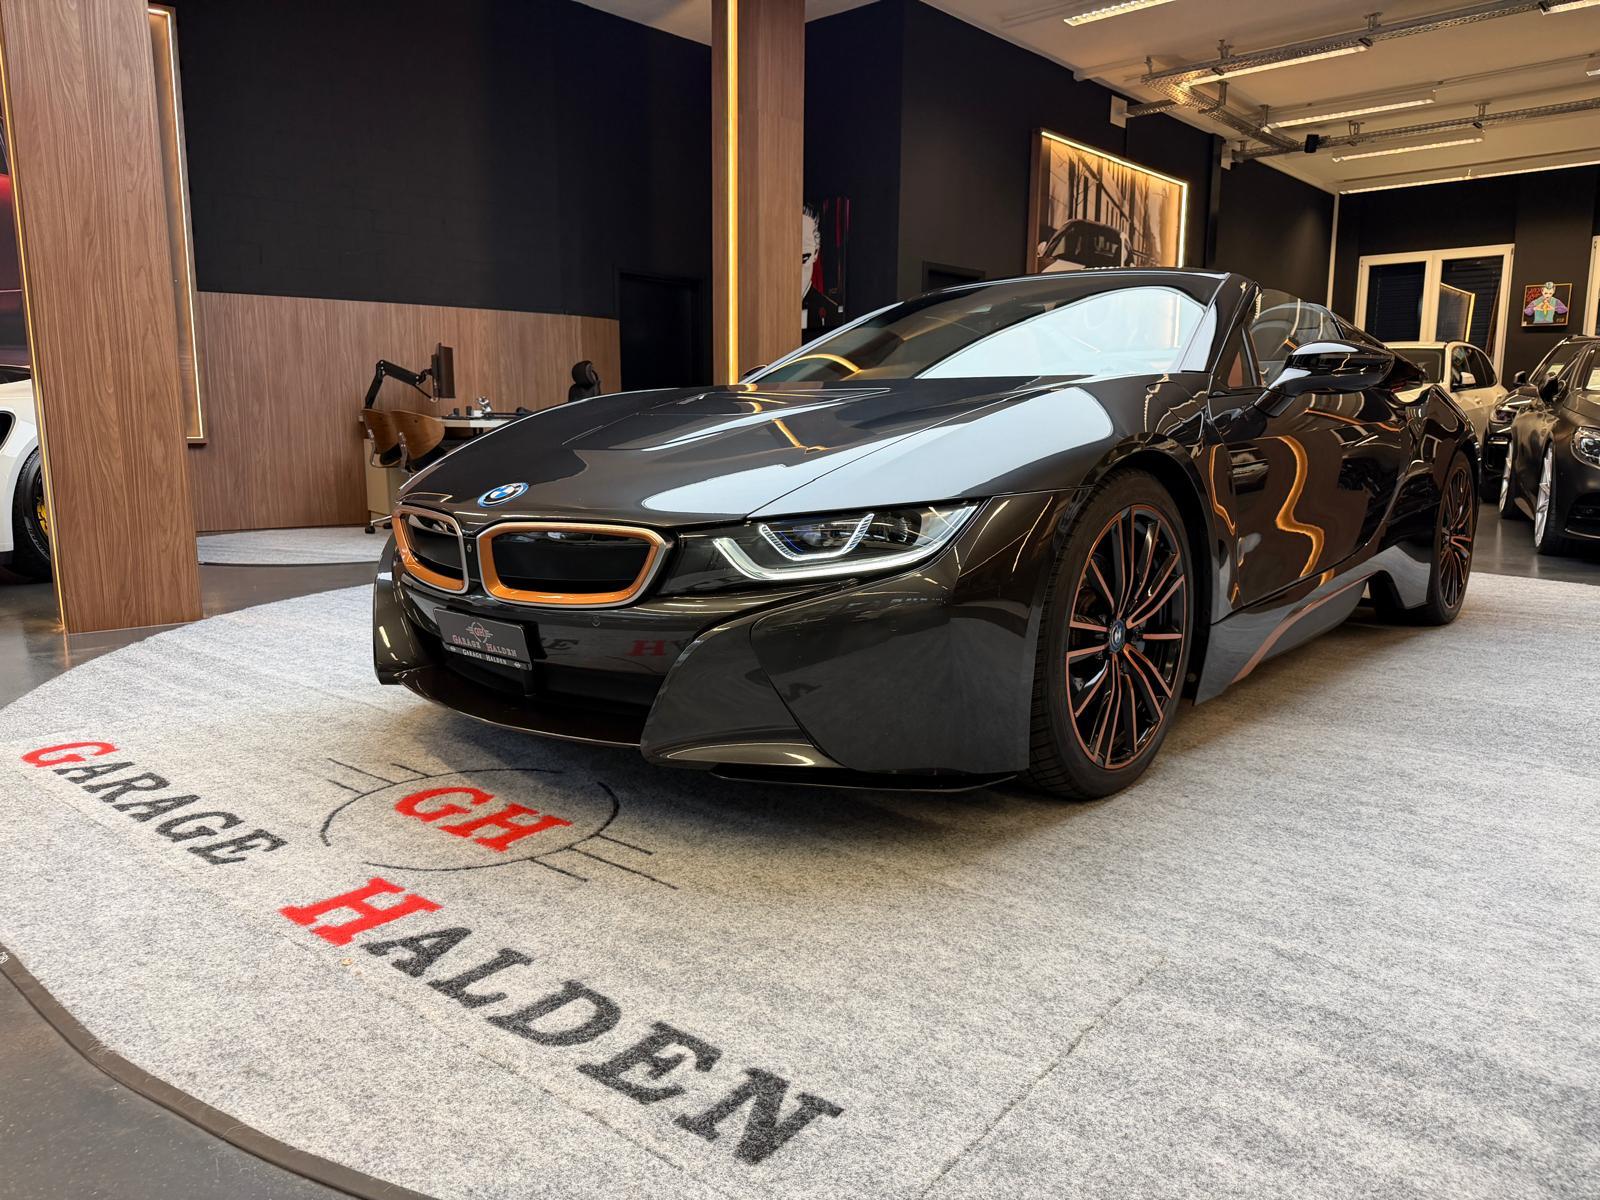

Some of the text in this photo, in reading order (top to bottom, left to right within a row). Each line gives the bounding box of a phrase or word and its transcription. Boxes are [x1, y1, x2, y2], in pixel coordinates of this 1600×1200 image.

[451, 634, 517, 657] GARAGE HALDEN
[462, 649, 507, 665] GARAGE HALDEN
[394, 785, 574, 853] GH
[22, 741, 845, 1165] GARAGE HALDEN
